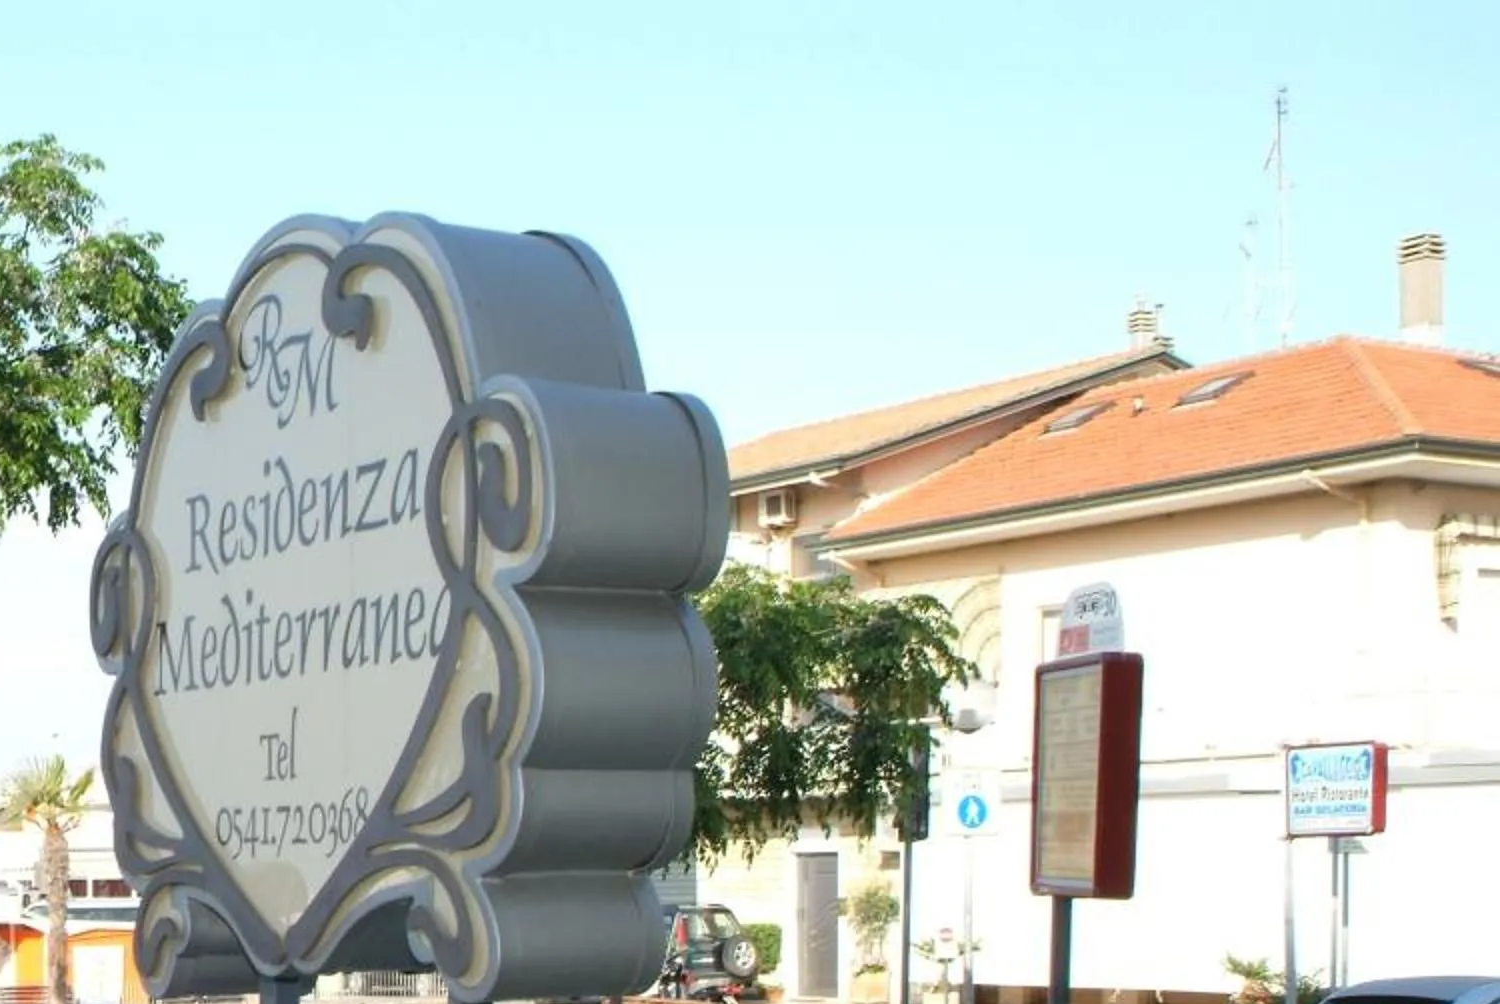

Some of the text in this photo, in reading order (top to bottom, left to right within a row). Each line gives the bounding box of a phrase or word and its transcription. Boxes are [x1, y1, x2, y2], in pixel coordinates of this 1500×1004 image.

[238, 294, 339, 430] RM
[184, 447, 421, 576] Residenza
[260, 706, 297, 781] Tel
[215, 786, 369, 860] 0541.720368
